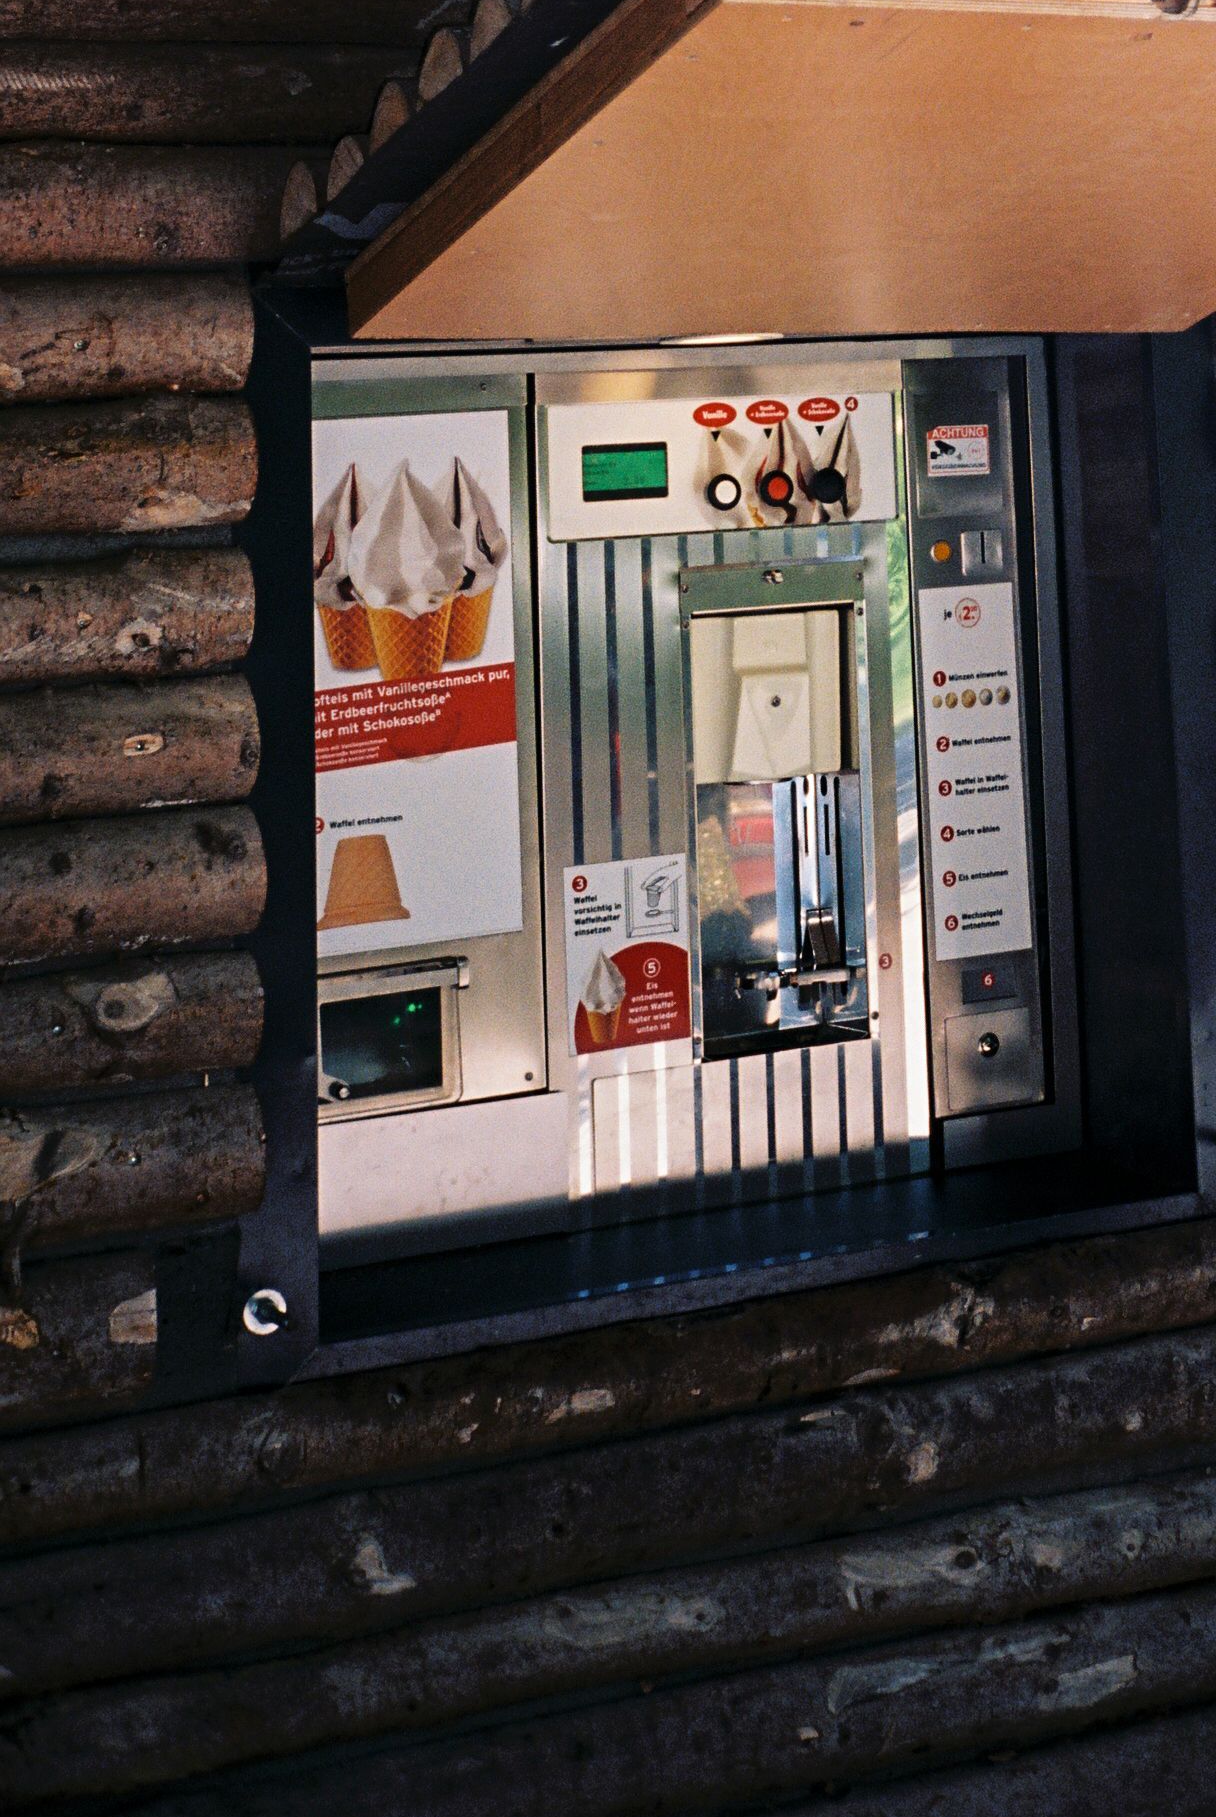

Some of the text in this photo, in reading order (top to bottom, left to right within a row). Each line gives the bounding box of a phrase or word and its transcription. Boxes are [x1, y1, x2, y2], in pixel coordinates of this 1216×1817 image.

[702, 409, 728, 420] Vanille
[932, 427, 984, 439] ACHTUNG
[944, 609, 952, 621] je
[949, 673, 975, 681] Münzen
[976, 670, 1008, 679] einwerfen
[352, 688, 373, 702] mit
[377, 672, 486, 697] Vanillegeschmack
[488, 670, 511, 682] pur,
[315, 728, 334, 739] der
[338, 723, 359, 735] mit
[952, 738, 973, 747] Waffel
[974, 735, 1011, 745] entnehmen
[955, 777, 976, 786] Waffel
[956, 784, 1009, 796] halter einsetzen
[330, 819, 355, 828] Waffel
[357, 815, 403, 825] entnehmen
[977, 825, 1000, 834] wählen
[971, 870, 1008, 880] entnehmen
[574, 894, 598, 904] Waffel
[574, 903, 613, 915] vorsichtig
[962, 909, 1003, 920] Wechselgeld
[574, 914, 620, 925] Waffelhalter
[962, 920, 1000, 931] entnehmen
[574, 926, 612, 937] einsetzen
[646, 982, 658, 990] Eis
[631, 991, 674, 1003] entnehmen
[628, 1001, 676, 1013] wenn Waffel-
[628, 1011, 678, 1024] halter wieder
[636, 1022, 671, 1034] unten ist
